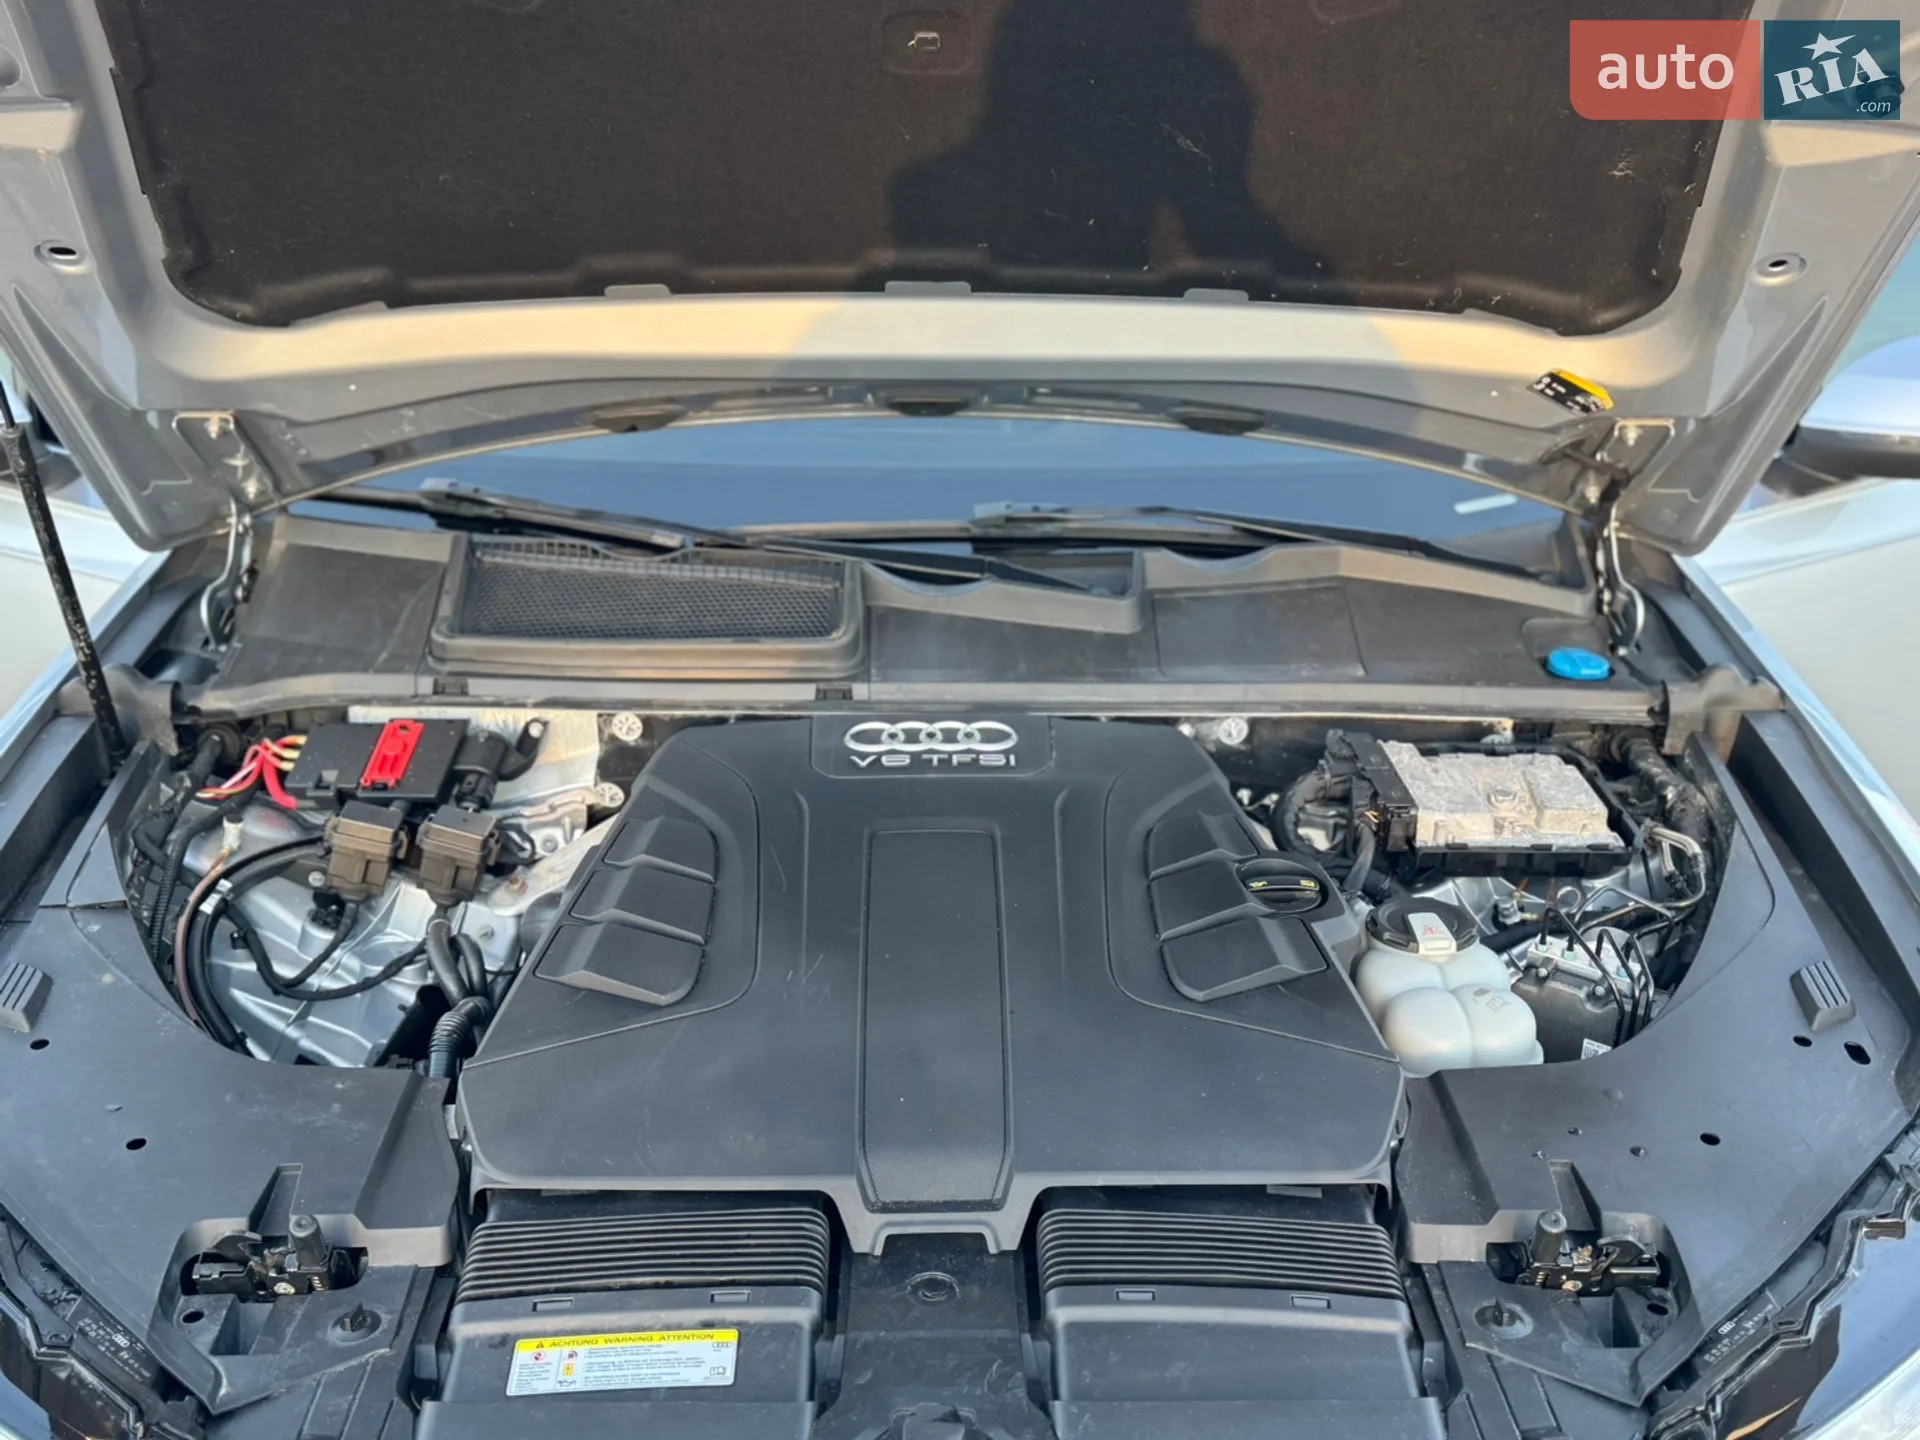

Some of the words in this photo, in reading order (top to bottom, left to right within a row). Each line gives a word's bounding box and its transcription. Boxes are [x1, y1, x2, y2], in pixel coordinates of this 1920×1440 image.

[850, 754, 911, 768] V6
[921, 754, 1017, 767] TFSI
[549, 1338, 599, 1348] ACHTUNG
[603, 1335, 654, 1345] WARNING
[658, 1332, 715, 1342] ATTENTION
